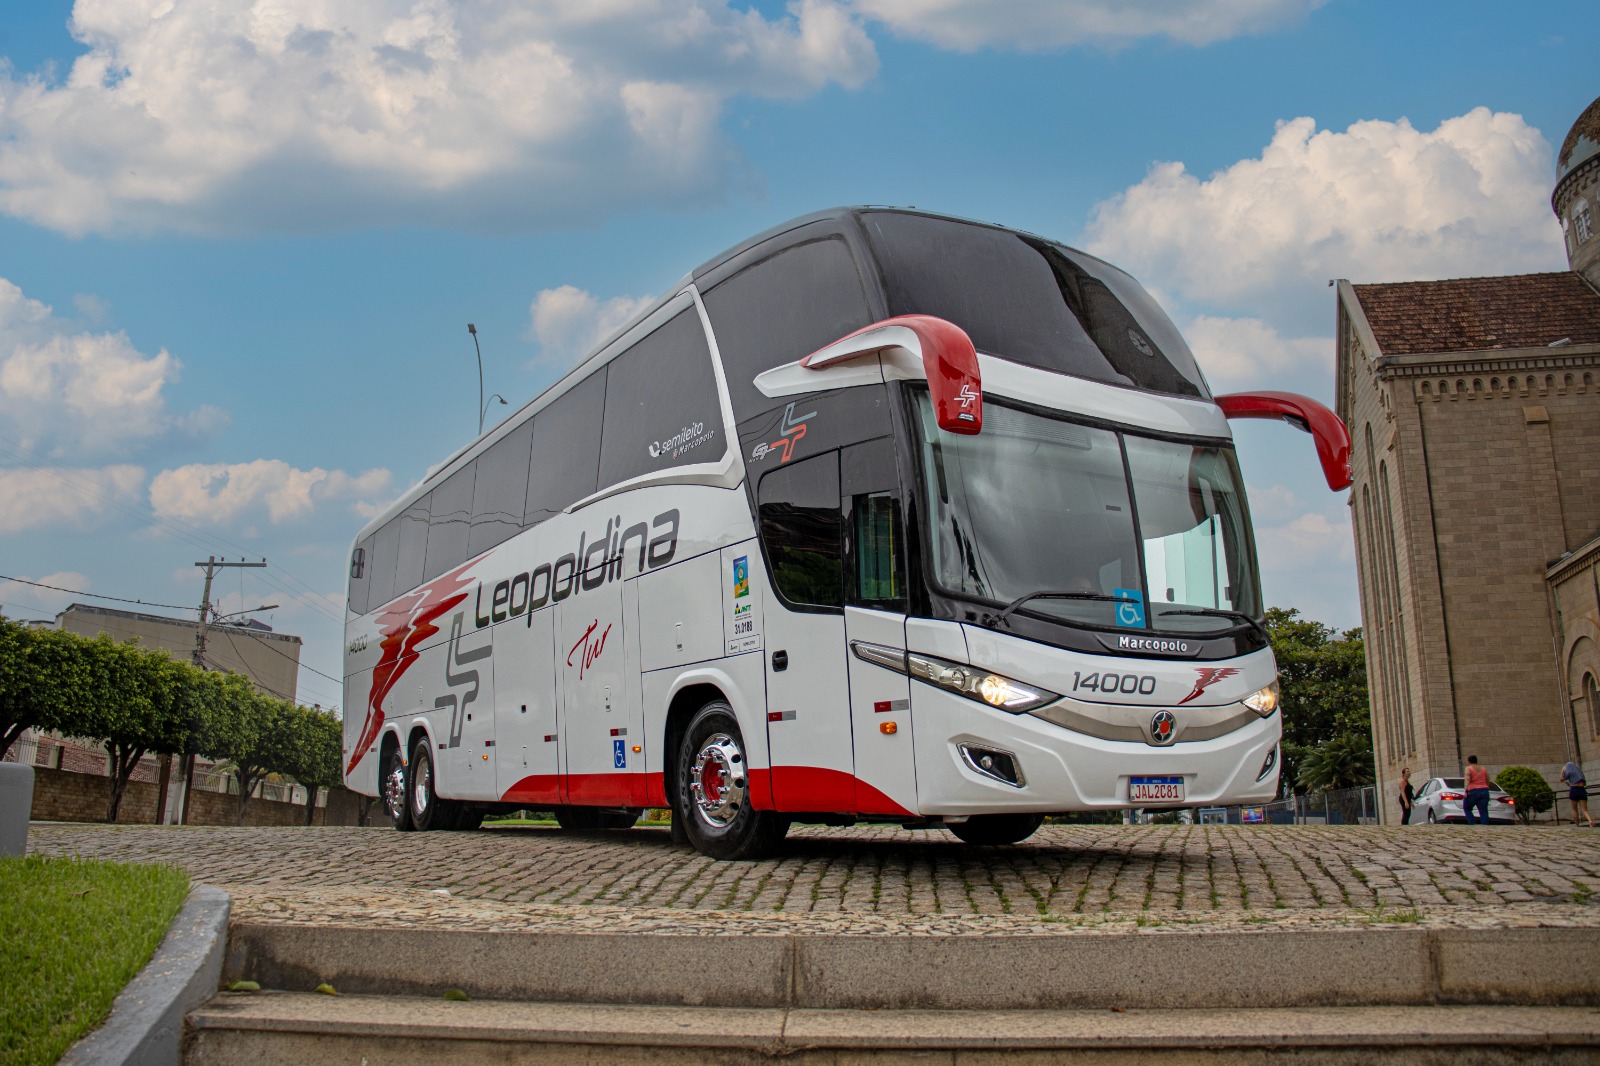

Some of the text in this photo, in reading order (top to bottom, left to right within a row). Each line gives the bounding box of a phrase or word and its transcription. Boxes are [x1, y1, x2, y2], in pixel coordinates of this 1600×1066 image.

[661, 421, 704, 454] semileito
[678, 430, 715, 456] Marcopolo
[475, 508, 680, 629] Leopoldina
[566, 618, 612, 681] Tur
[1118, 636, 1188, 652] Marcopolo
[1072, 671, 1157, 695] 14000
[1135, 784, 1179, 799] JAL2C81
